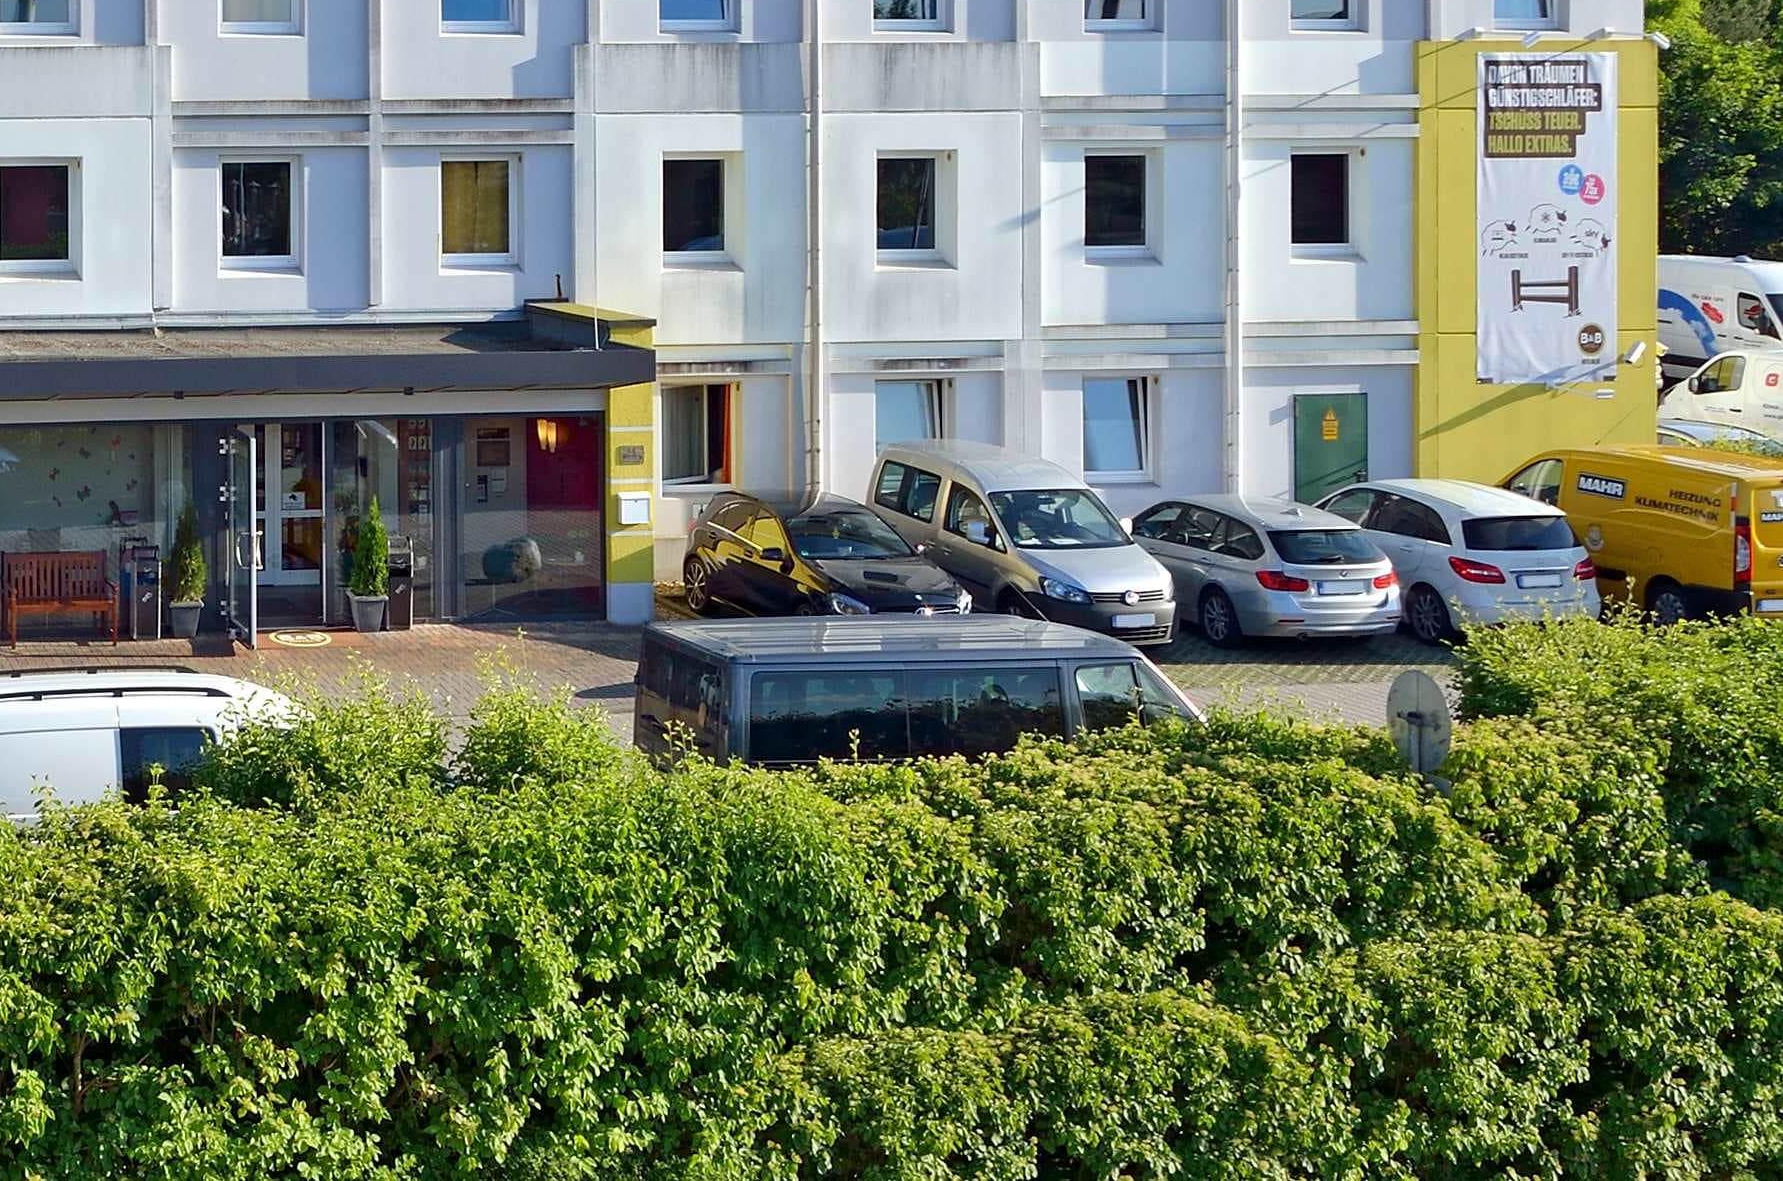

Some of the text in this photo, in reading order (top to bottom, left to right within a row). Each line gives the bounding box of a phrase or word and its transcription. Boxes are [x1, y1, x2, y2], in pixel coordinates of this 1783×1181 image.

[1488, 62, 1585, 84] DAVON TRÄUMEN
[1488, 85, 1599, 108] GÜNSTIGSCHLÄFER:
[1488, 108, 1582, 131] TSCHÜSS TEUER.
[1488, 134, 1573, 154] HALLO EXTRAS.
[1580, 332, 1602, 344] B&B
[1578, 475, 1625, 497] MAHR
[1634, 495, 1720, 522] KLIMATECHNIK
[1668, 489, 1722, 508] HEIZUNG
